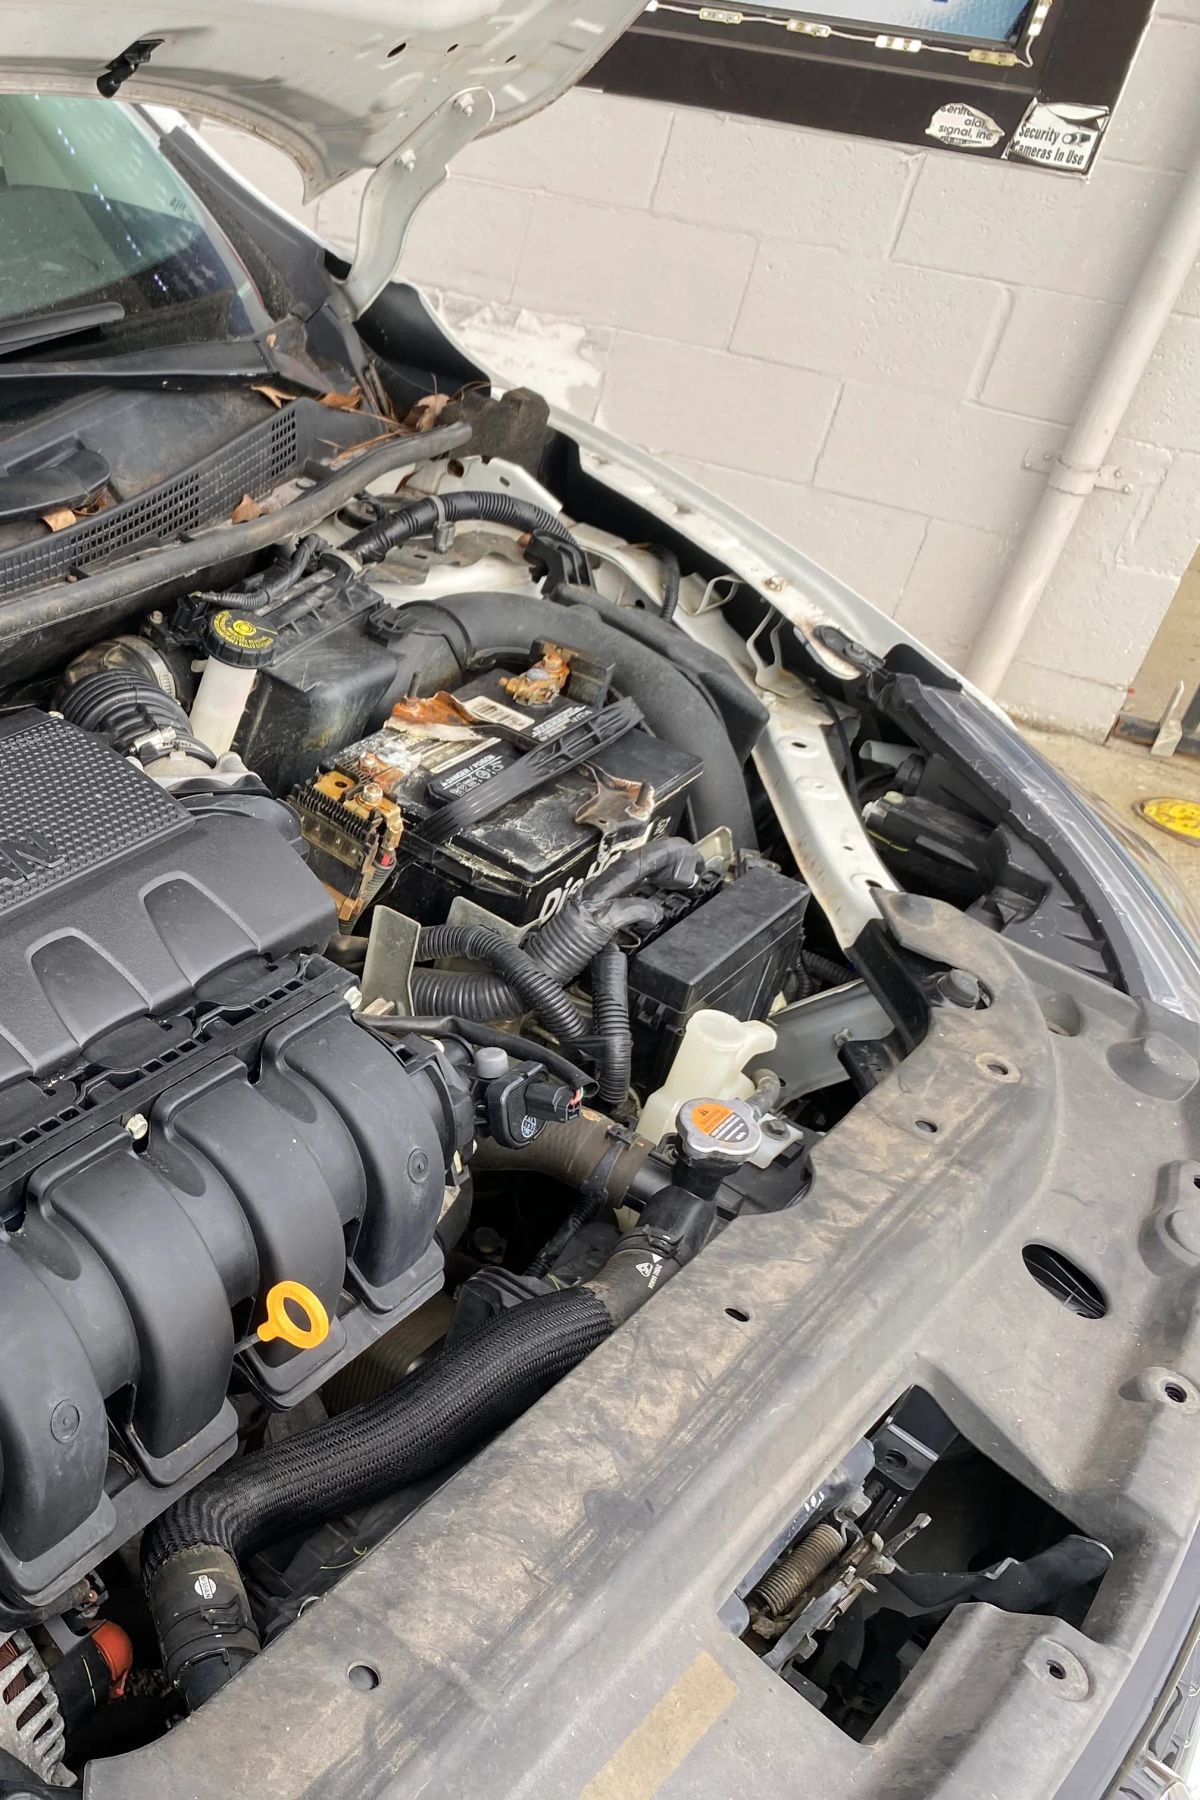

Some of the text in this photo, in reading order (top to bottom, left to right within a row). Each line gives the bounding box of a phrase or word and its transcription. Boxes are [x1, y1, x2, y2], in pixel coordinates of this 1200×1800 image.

[938, 125, 972, 138] signal,
[1019, 123, 1060, 145] Security
[1054, 147, 1065, 161] In
[1065, 150, 1084, 165] Use
[199, 1575, 213, 1599] NISSAN
